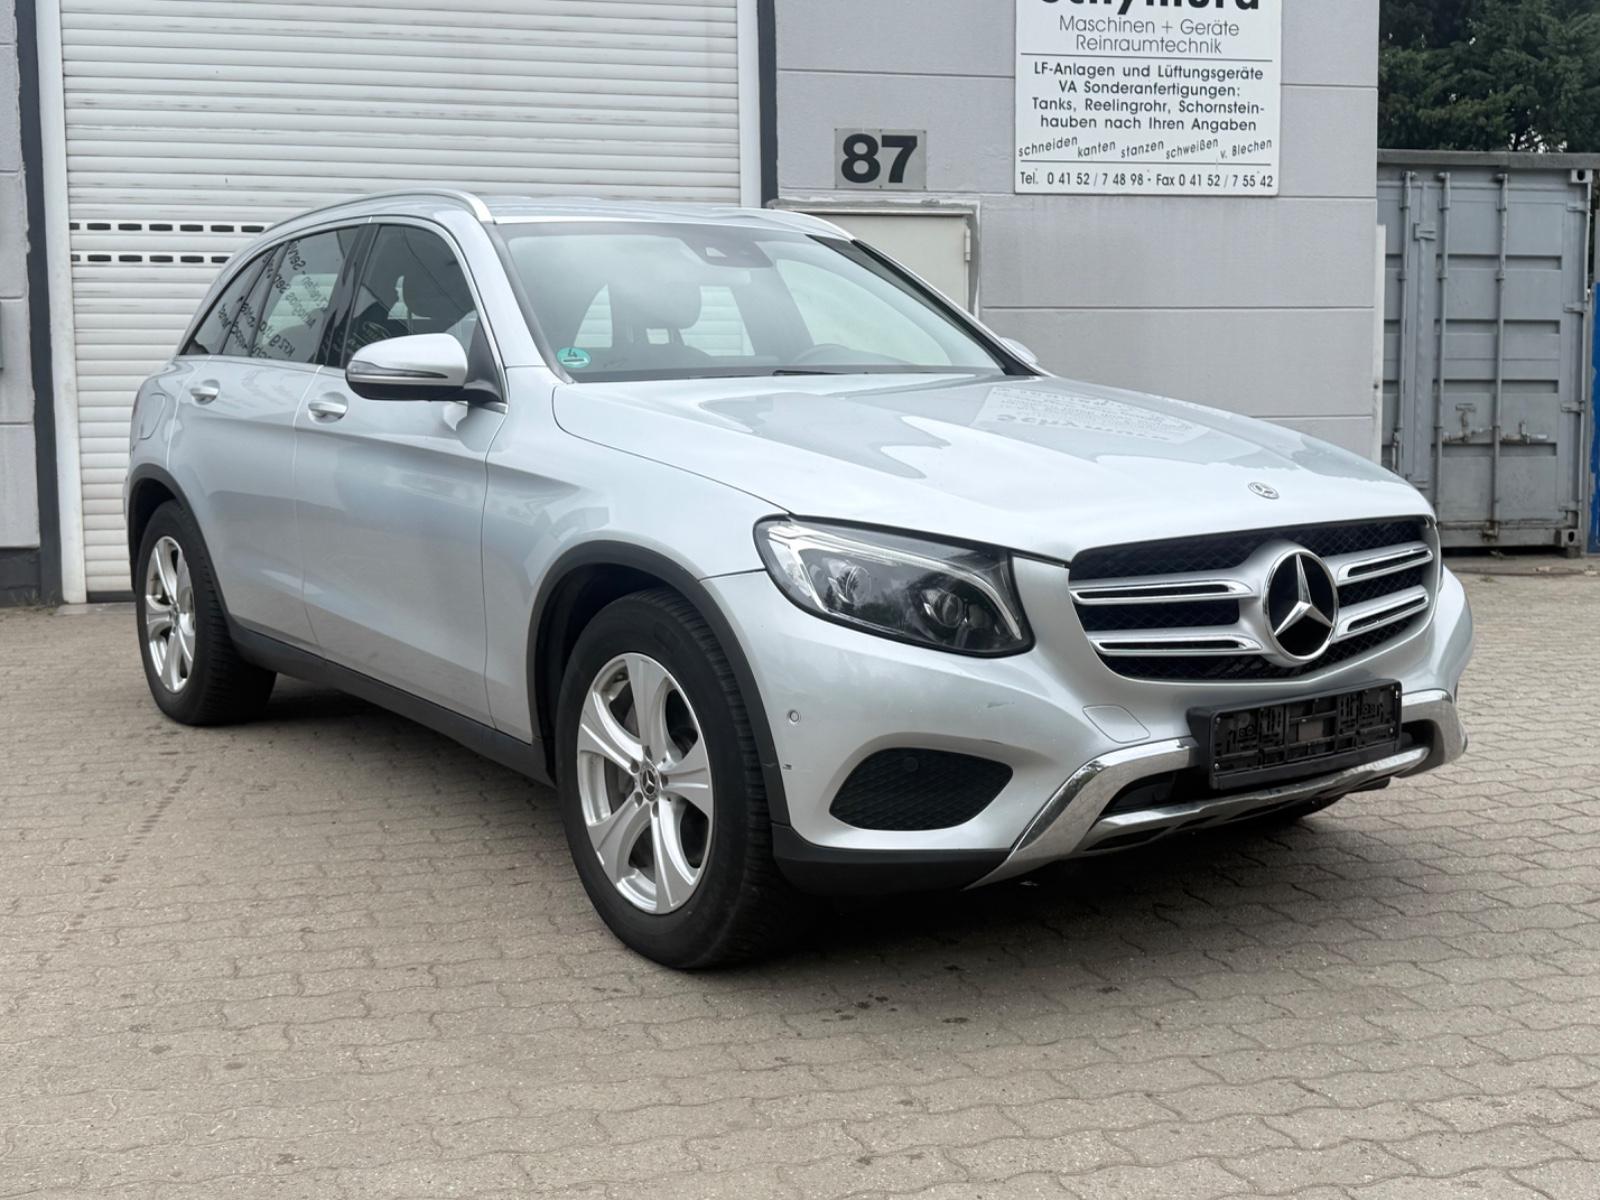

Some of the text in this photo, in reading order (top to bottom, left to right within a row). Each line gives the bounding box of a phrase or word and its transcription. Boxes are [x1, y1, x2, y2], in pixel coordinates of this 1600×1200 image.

[1059, 14, 1240, 37] Maschinen + Geräte
[1076, 34, 1222, 54] Reinraumtechnik
[1034, 62, 1264, 82] LF-Anlagen und Lüftungsgeräte
[1058, 80, 1241, 99] VA Sonderanfertigungen:
[1032, 97, 1265, 115] Tanks, Reelingrohr, Schornstein-
[1040, 115, 1257, 134] hauben nach Ihren Angaben
[1018, 135, 1078, 158] schneiden
[1077, 140, 1117, 159] kanten
[1120, 139, 1165, 159] stanzen
[1165, 137, 1219, 160] schweißen
[1231, 138, 1273, 158] Blechen
[841, 133, 918, 184] 87
[1058, 173, 1071, 185] 41
[1076, 172, 1090, 185] 52
[1113, 173, 1126, 186] 48
[1130, 173, 1144, 186] 98
[1156, 173, 1175, 187] Fax
[1189, 174, 1202, 187] 41
[1207, 174, 1221, 187] 52
[1242, 175, 1256, 188] 55
[1260, 175, 1273, 188] 42
